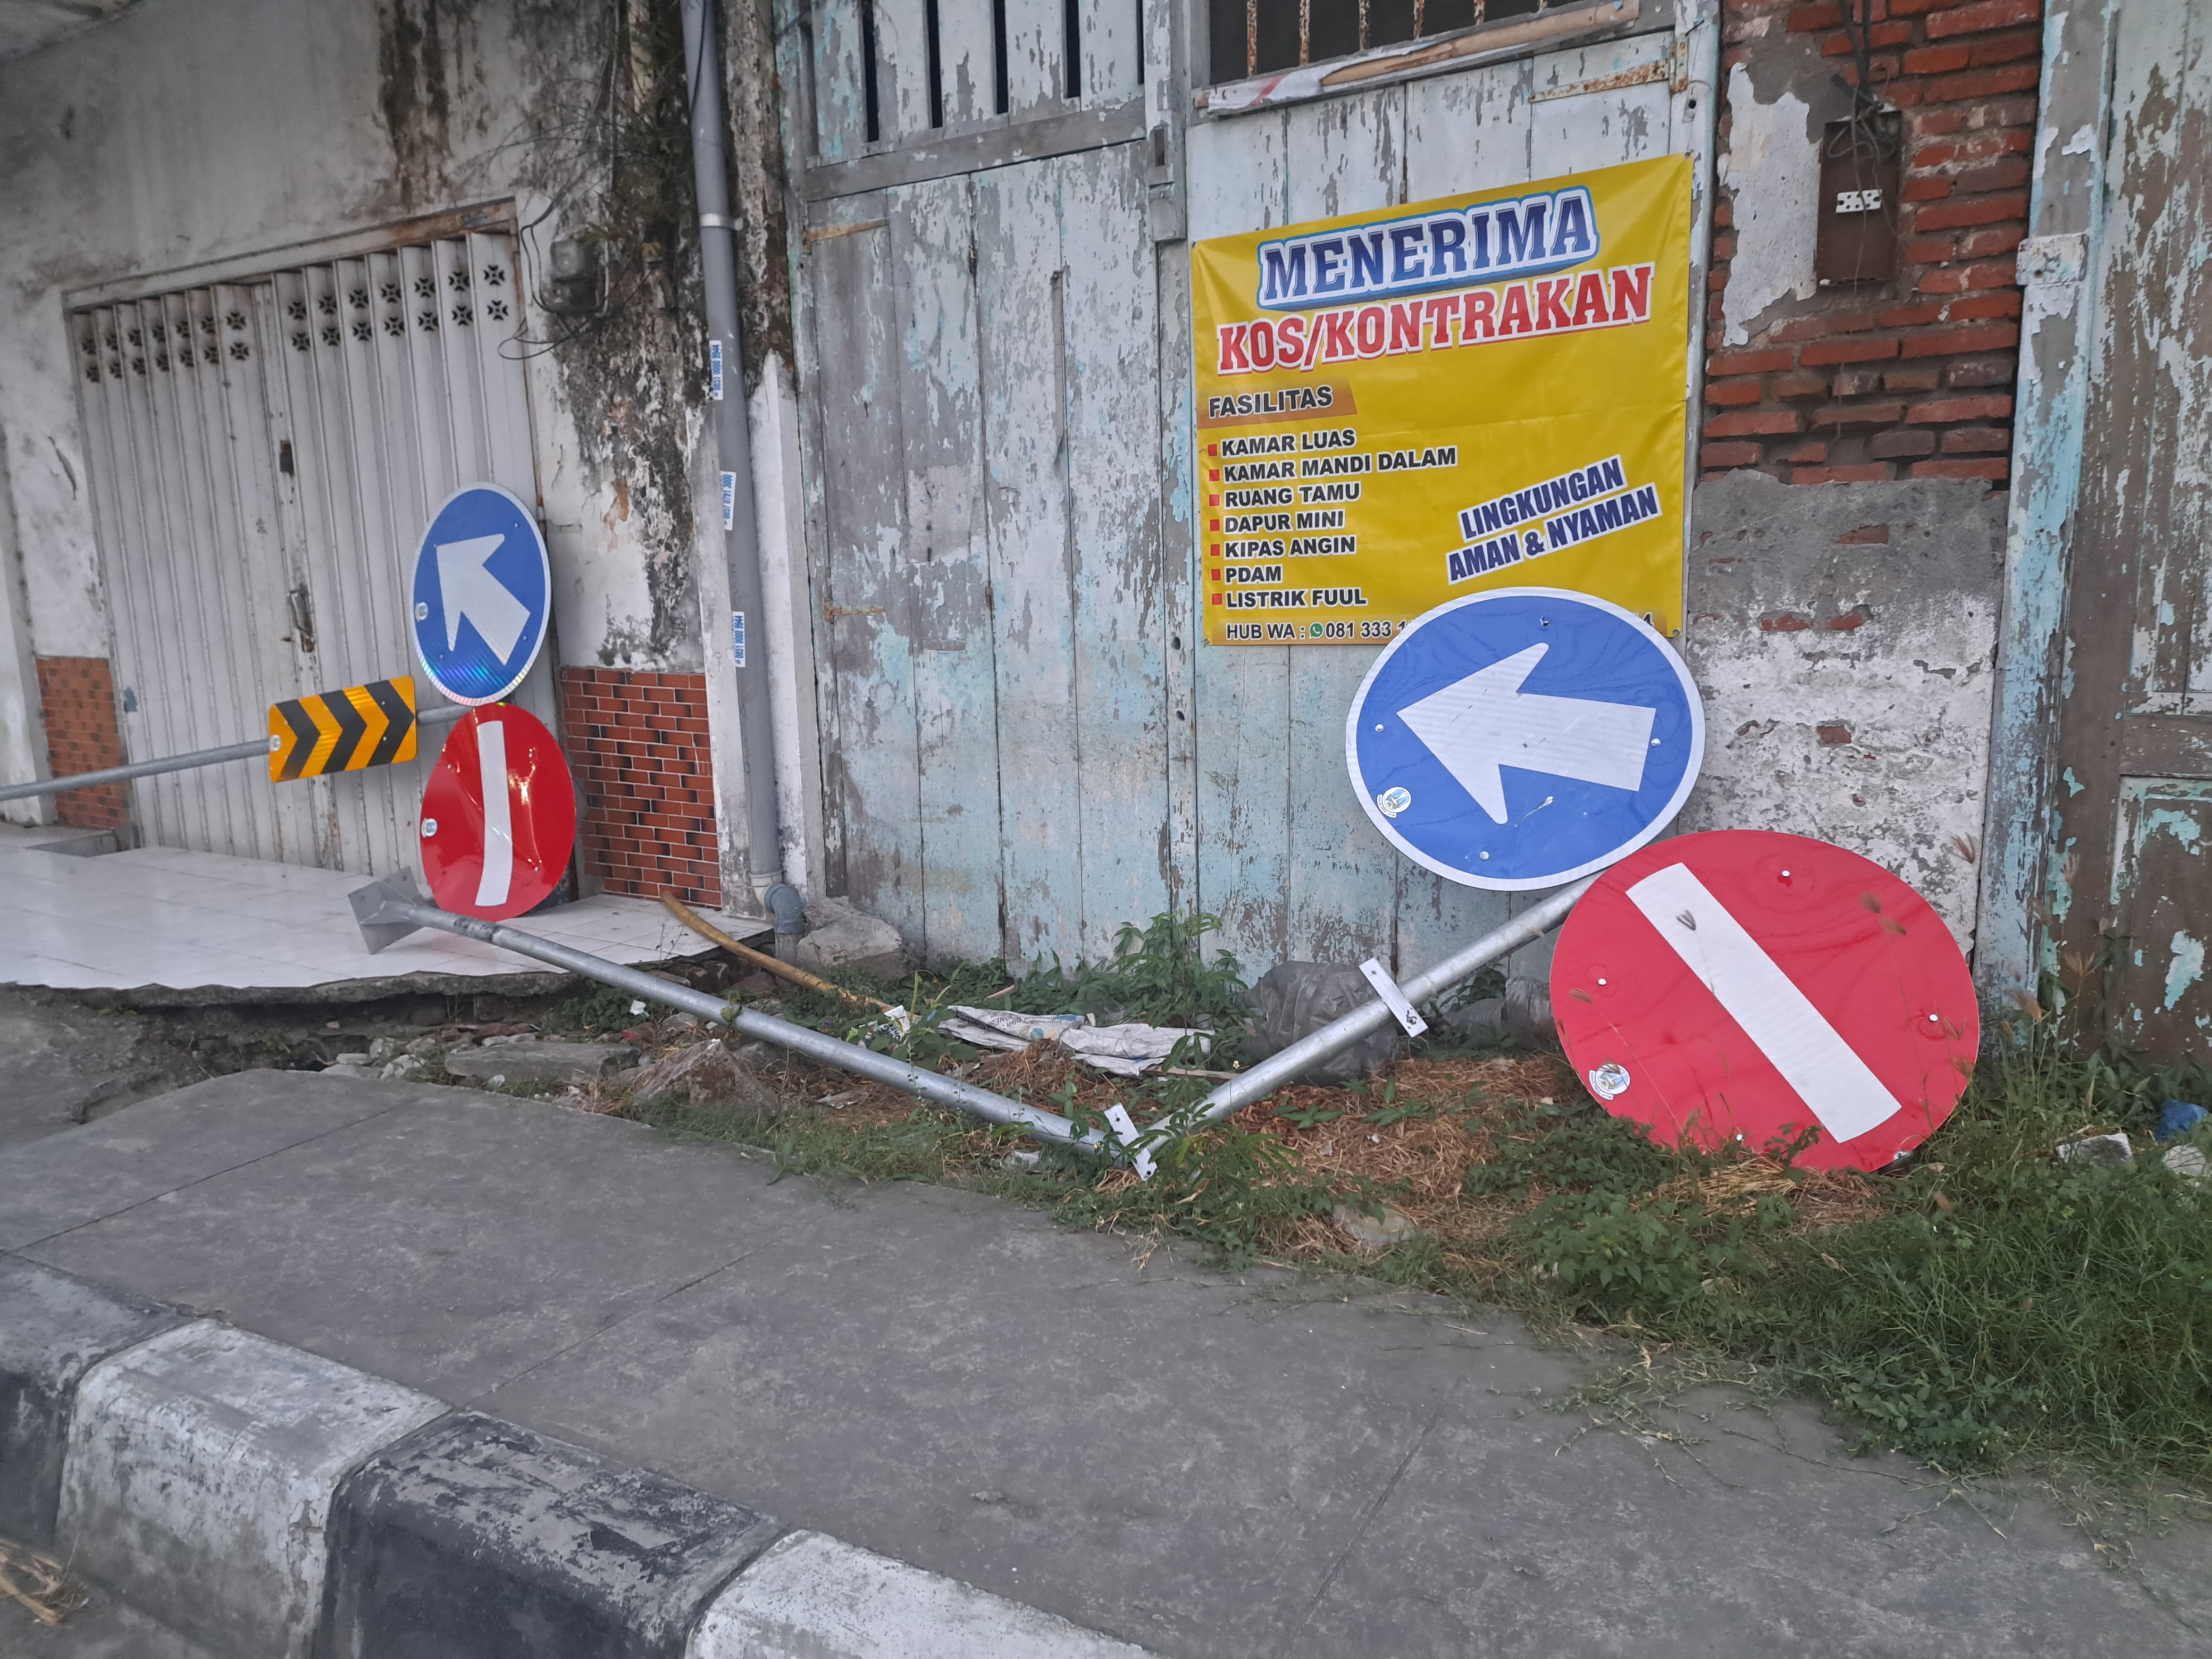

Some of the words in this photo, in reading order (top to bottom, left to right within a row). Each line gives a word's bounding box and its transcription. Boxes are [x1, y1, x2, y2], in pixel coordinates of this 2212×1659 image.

[1263, 195, 1592, 302] MENERIMA
[1218, 265, 1653, 374] KOS/KONTRAKAN
[1208, 386, 1334, 418] FASILITAS
[1222, 435, 1295, 457] KAMAR
[1301, 429, 1356, 450] LUAS
[1224, 461, 1295, 482] KAMAR
[1302, 455, 1371, 476] MANDI
[1378, 447, 1456, 469] DALAM
[1225, 488, 1293, 508] RUANG
[1300, 483, 1361, 503] TAMU
[1460, 457, 1624, 540] LINGKUNGAN
[1225, 514, 1291, 533] DAPUR
[1297, 510, 1344, 529] MINI
[1448, 533, 1521, 582] AMAN
[1524, 531, 1546, 556] &
[1545, 485, 1659, 549] NYAMAN
[1225, 539, 1285, 558] KIPAS
[1290, 536, 1356, 555] ANGIN
[1226, 566, 1282, 583] PDAM
[1226, 591, 1306, 608] LISTRIK
[1312, 588, 1367, 606] FUUL
[1226, 624, 1262, 640] HUB
[1326, 621, 1354, 638] 081
[1361, 621, 1392, 638] 333
